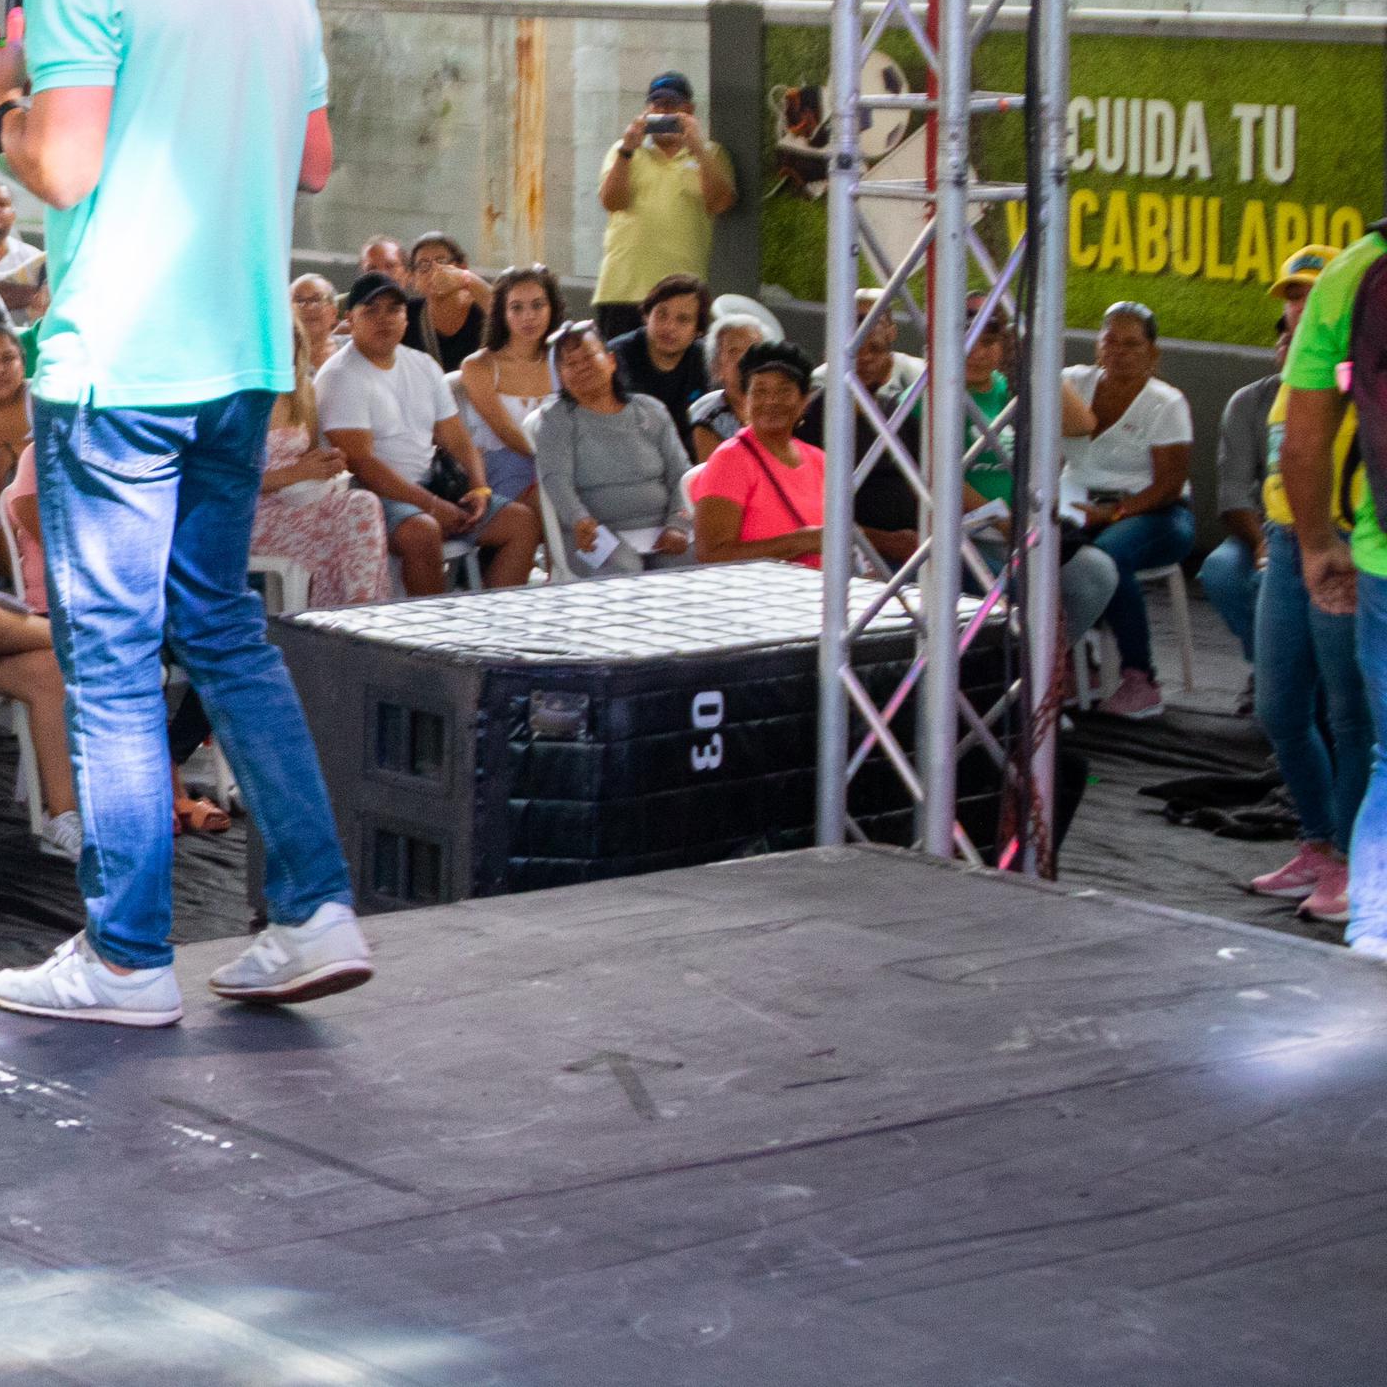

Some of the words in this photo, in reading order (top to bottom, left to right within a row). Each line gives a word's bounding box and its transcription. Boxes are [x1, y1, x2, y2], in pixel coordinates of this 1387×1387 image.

[1065, 95, 1212, 181] CUIDA
[1231, 102, 1297, 185] TU
[1006, 188, 1365, 283] VCABULARIO
[691, 690, 725, 771] 03
